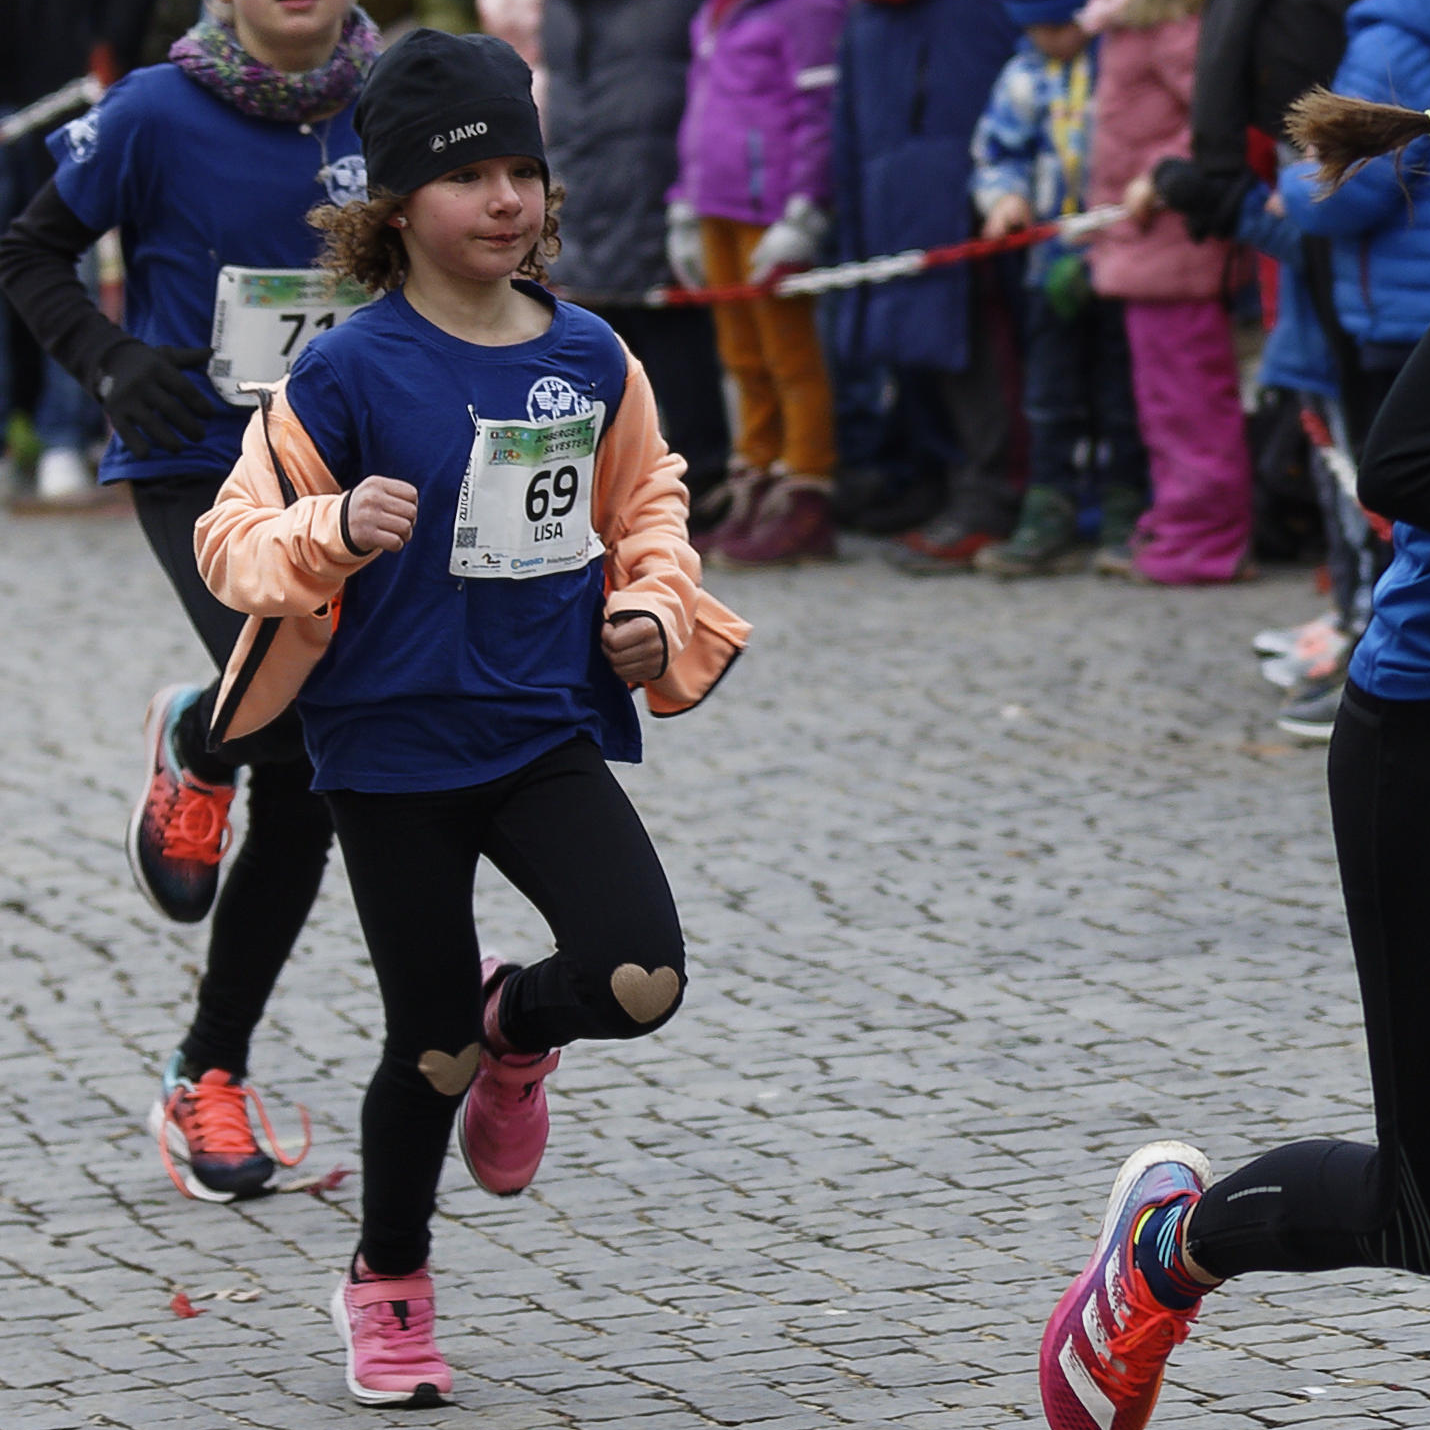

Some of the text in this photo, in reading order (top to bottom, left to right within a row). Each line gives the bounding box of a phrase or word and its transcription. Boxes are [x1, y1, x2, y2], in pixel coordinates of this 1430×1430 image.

[449, 121, 488, 144] JAKO
[525, 465, 579, 522] 69
[534, 522, 563, 542] LISA
